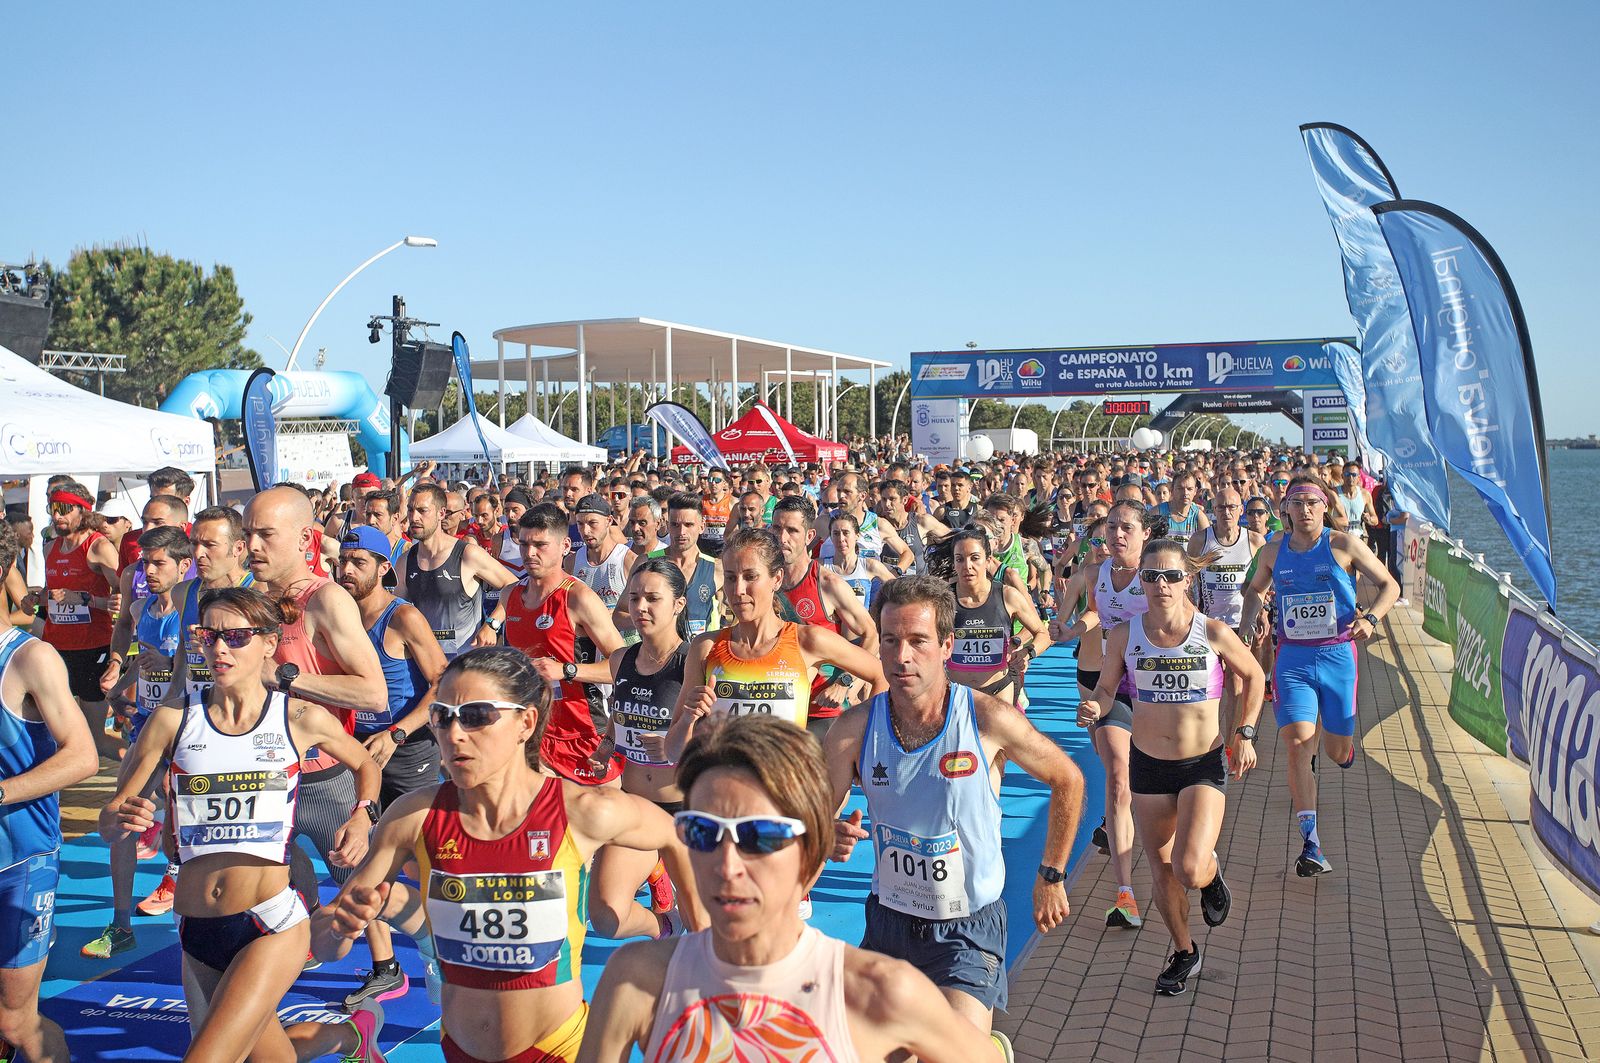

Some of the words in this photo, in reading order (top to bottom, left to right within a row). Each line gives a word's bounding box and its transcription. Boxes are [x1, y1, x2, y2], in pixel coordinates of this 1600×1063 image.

[1059, 351, 1157, 365] CAMPEONATO
[1231, 357, 1273, 370] HUELVA
[1308, 356, 1331, 369] Wi
[977, 359, 1000, 390] 10
[1058, 369, 1074, 379] de
[1077, 366, 1127, 379] ESPAÑA
[1135, 364, 1157, 379] 10
[1163, 363, 1193, 379] km
[1166, 379, 1193, 387] Master
[1215, 573, 1236, 583] 360
[1292, 605, 1327, 619] 1629
[962, 641, 990, 653] 416
[1151, 673, 1189, 690] 490
[146, 683, 161, 698] 90
[624, 701, 670, 719] BARCO
[628, 715, 663, 725] RUNNING
[252, 733, 286, 746] CUA
[217, 771, 277, 782] RUNNING
[232, 782, 266, 792] LOOP
[206, 794, 257, 822] 501
[926, 839, 952, 853] 2023
[889, 850, 948, 882] 1018
[493, 890, 536, 901] LOOP
[459, 908, 529, 940] 483
[79, 1008, 107, 1017] de
